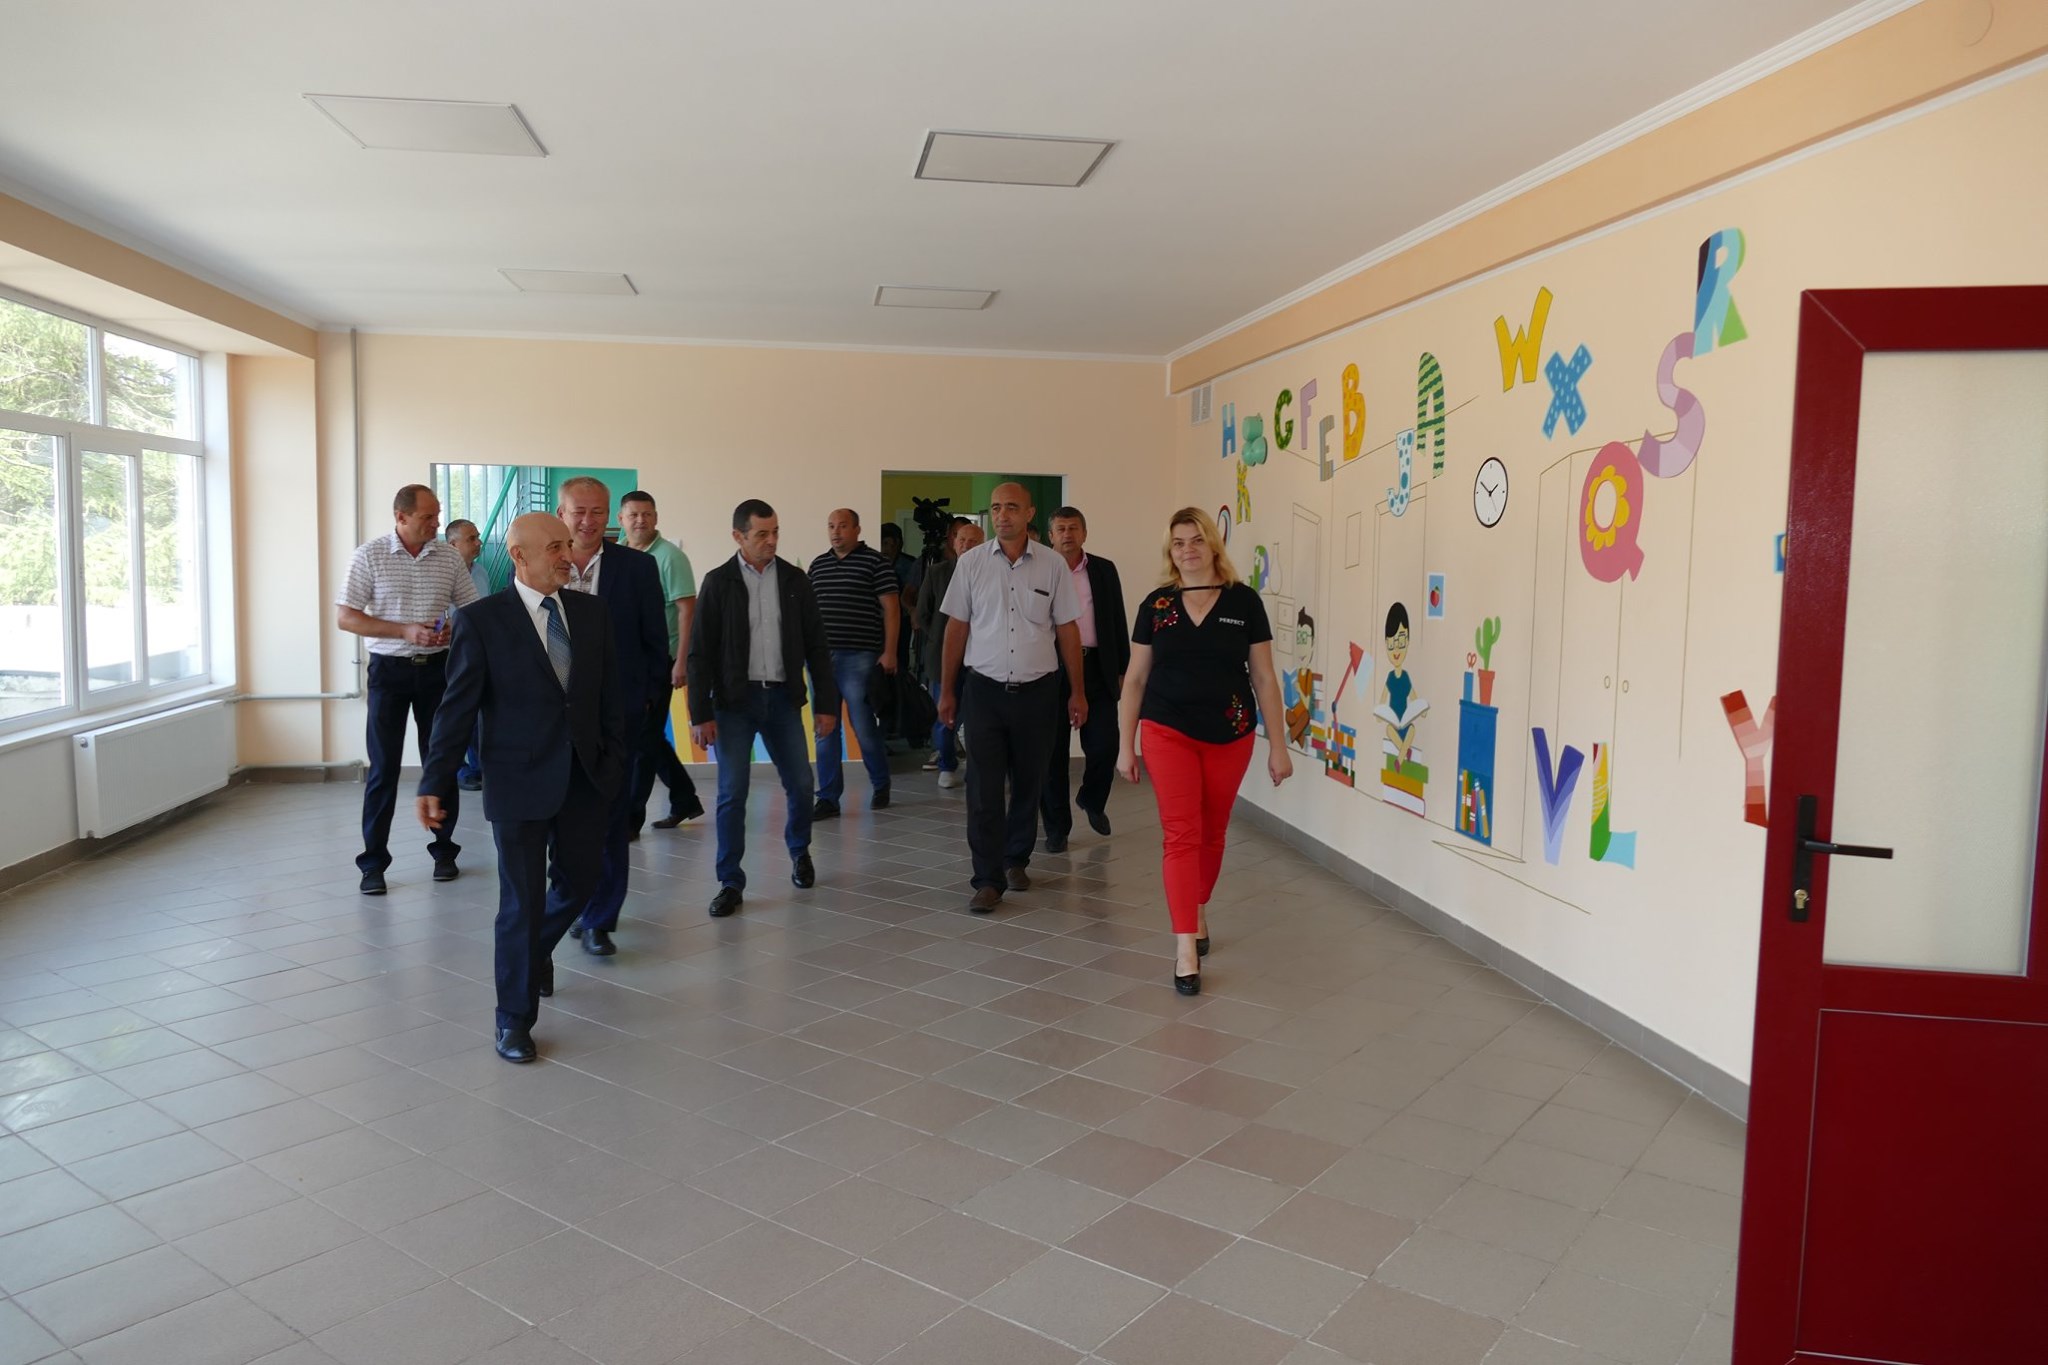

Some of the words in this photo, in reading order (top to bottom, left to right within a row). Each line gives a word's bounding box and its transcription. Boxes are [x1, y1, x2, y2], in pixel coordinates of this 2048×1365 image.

[1494, 286, 1553, 392] W
[1693, 227, 1748, 357] R
[1222, 403, 1236, 458] H
[1274, 389, 1294, 450] G
[1300, 379, 1317, 450] F
[1341, 363, 1366, 461] B
[1416, 352, 1445, 478] A
[1543, 343, 1592, 440] X
[1637, 332, 1705, 478] S
[1236, 459, 1251, 525] K
[1319, 415, 1335, 481] E
[1387, 428, 1414, 517] J
[1579, 441, 1644, 583] Q
[1218, 617, 1245, 626] PERFECT
[1531, 727, 1584, 866] V
[1590, 742, 1637, 869] L
[1720, 690, 1776, 828] Y
